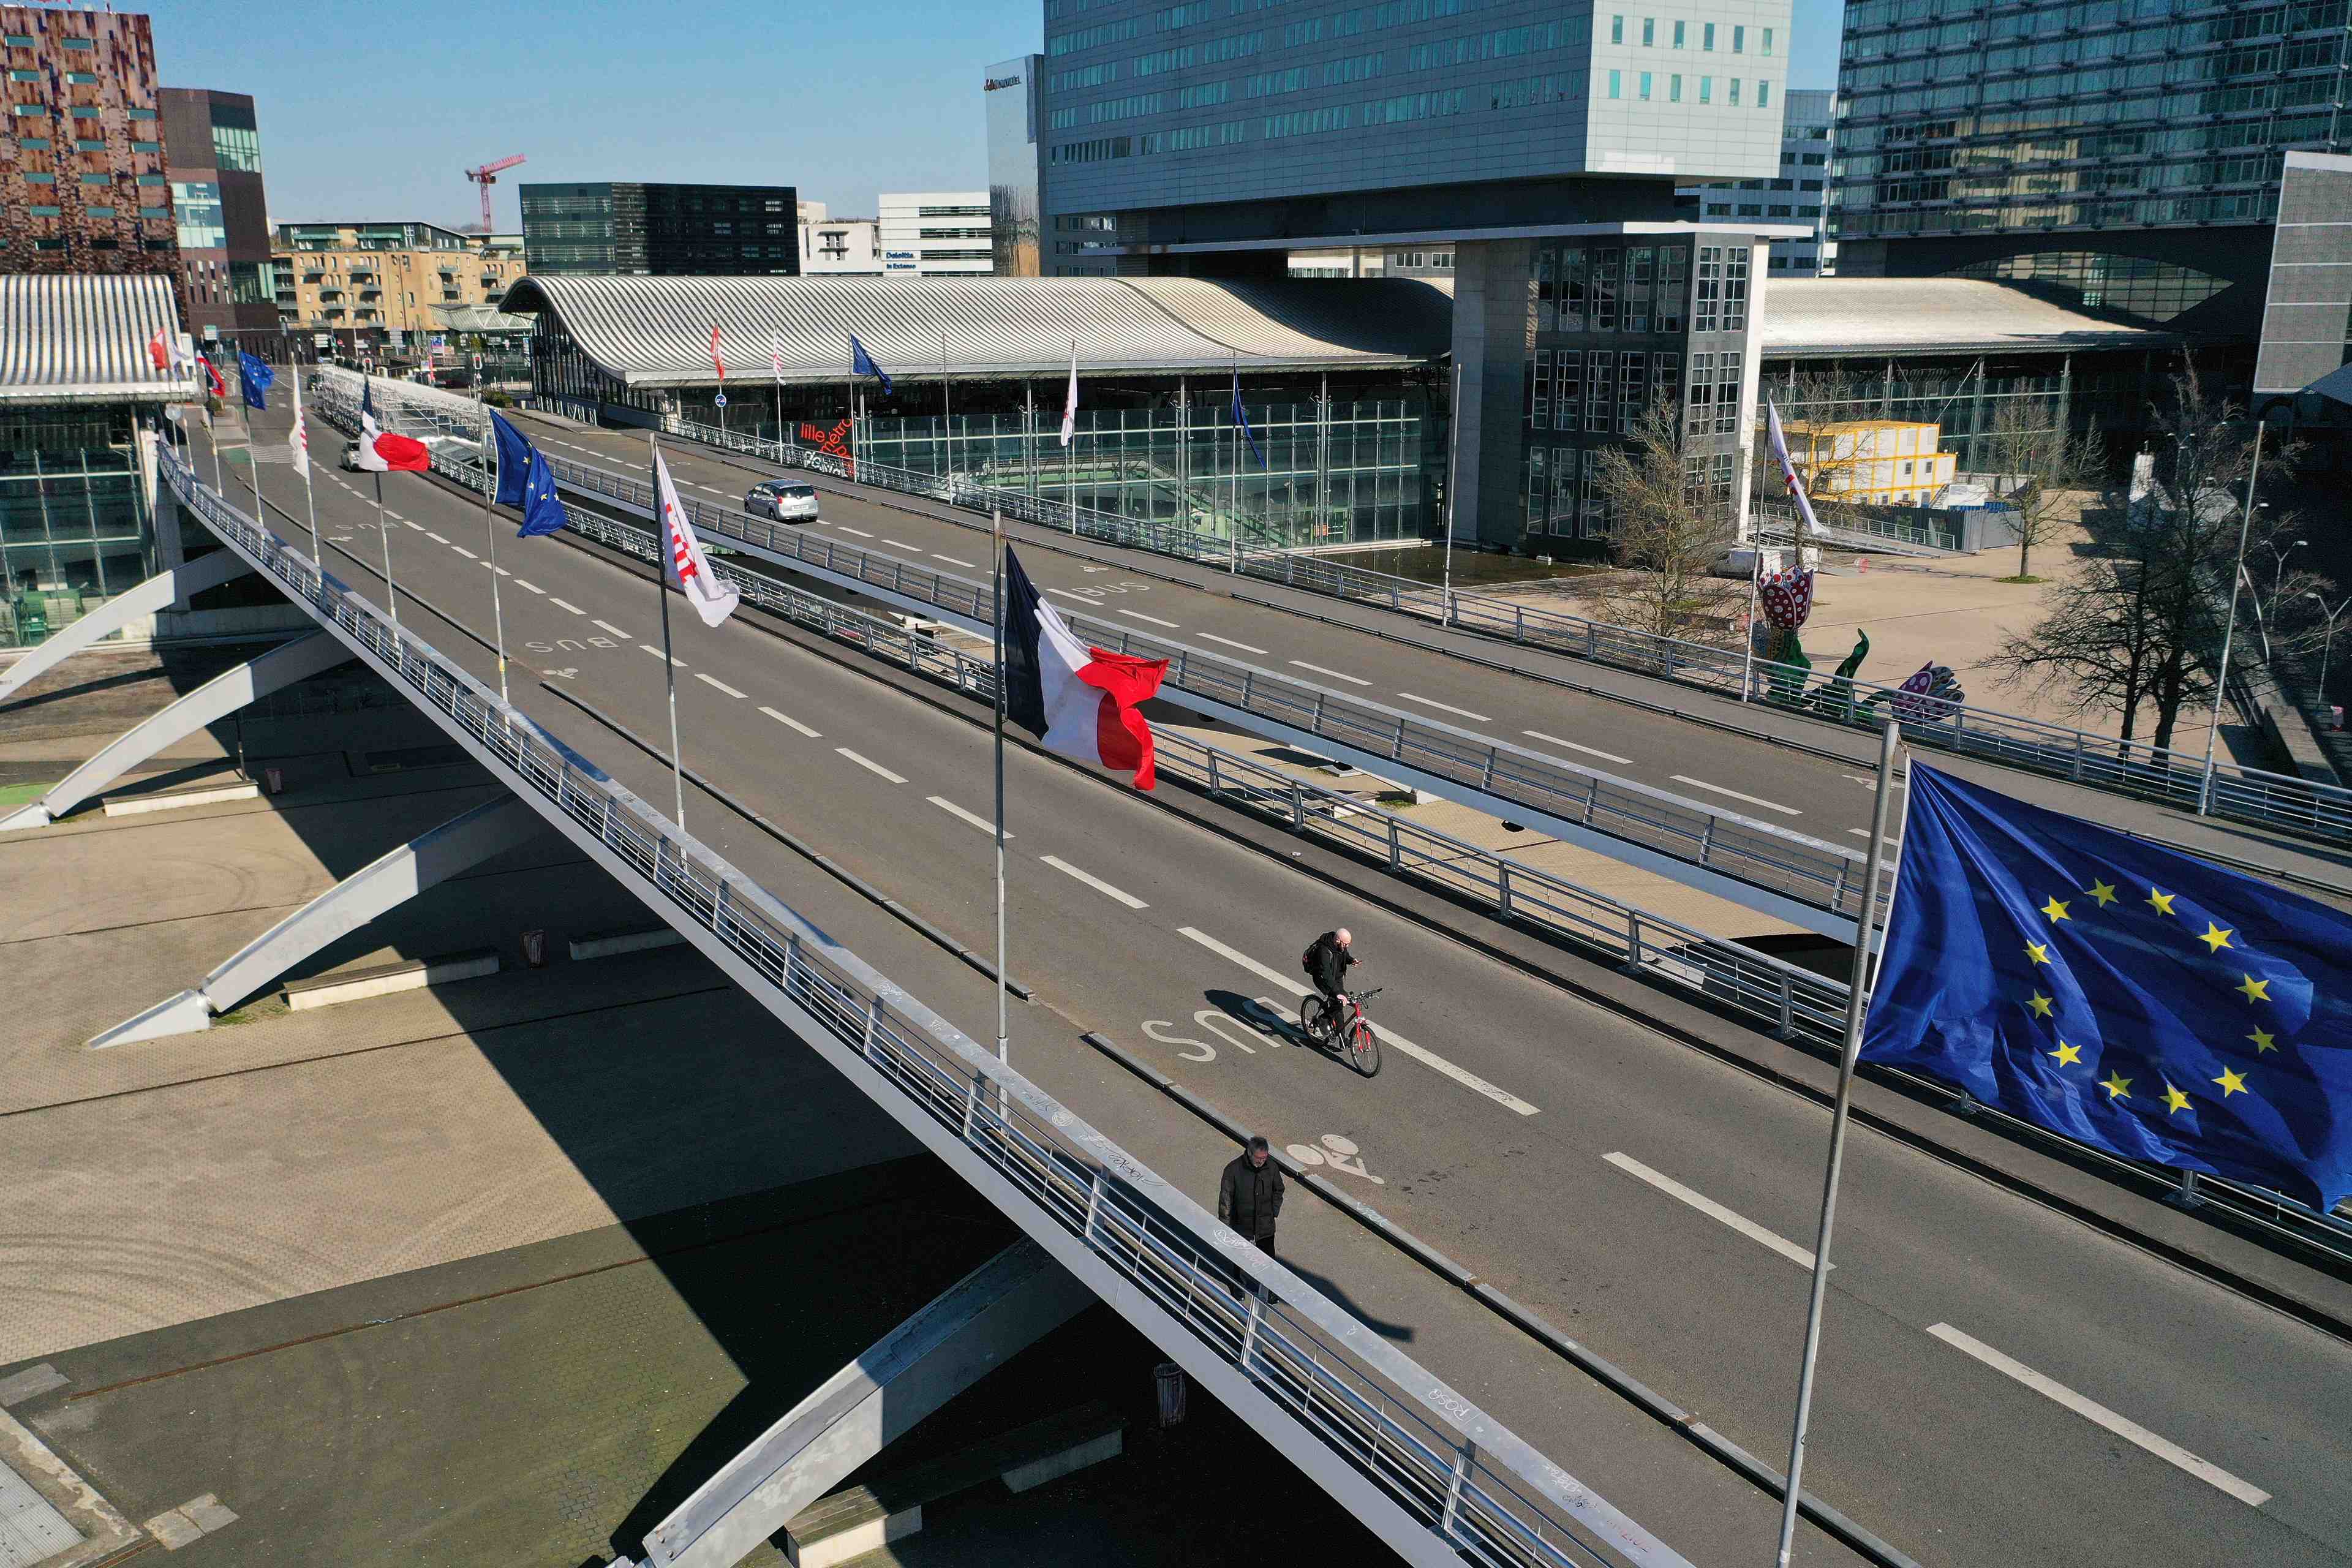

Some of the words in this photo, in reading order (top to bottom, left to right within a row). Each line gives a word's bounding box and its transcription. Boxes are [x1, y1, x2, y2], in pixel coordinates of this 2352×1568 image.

[801, 422, 825, 442] lille
[1072, 582, 1150, 597] BUS
[525, 637, 619, 653] BUS
